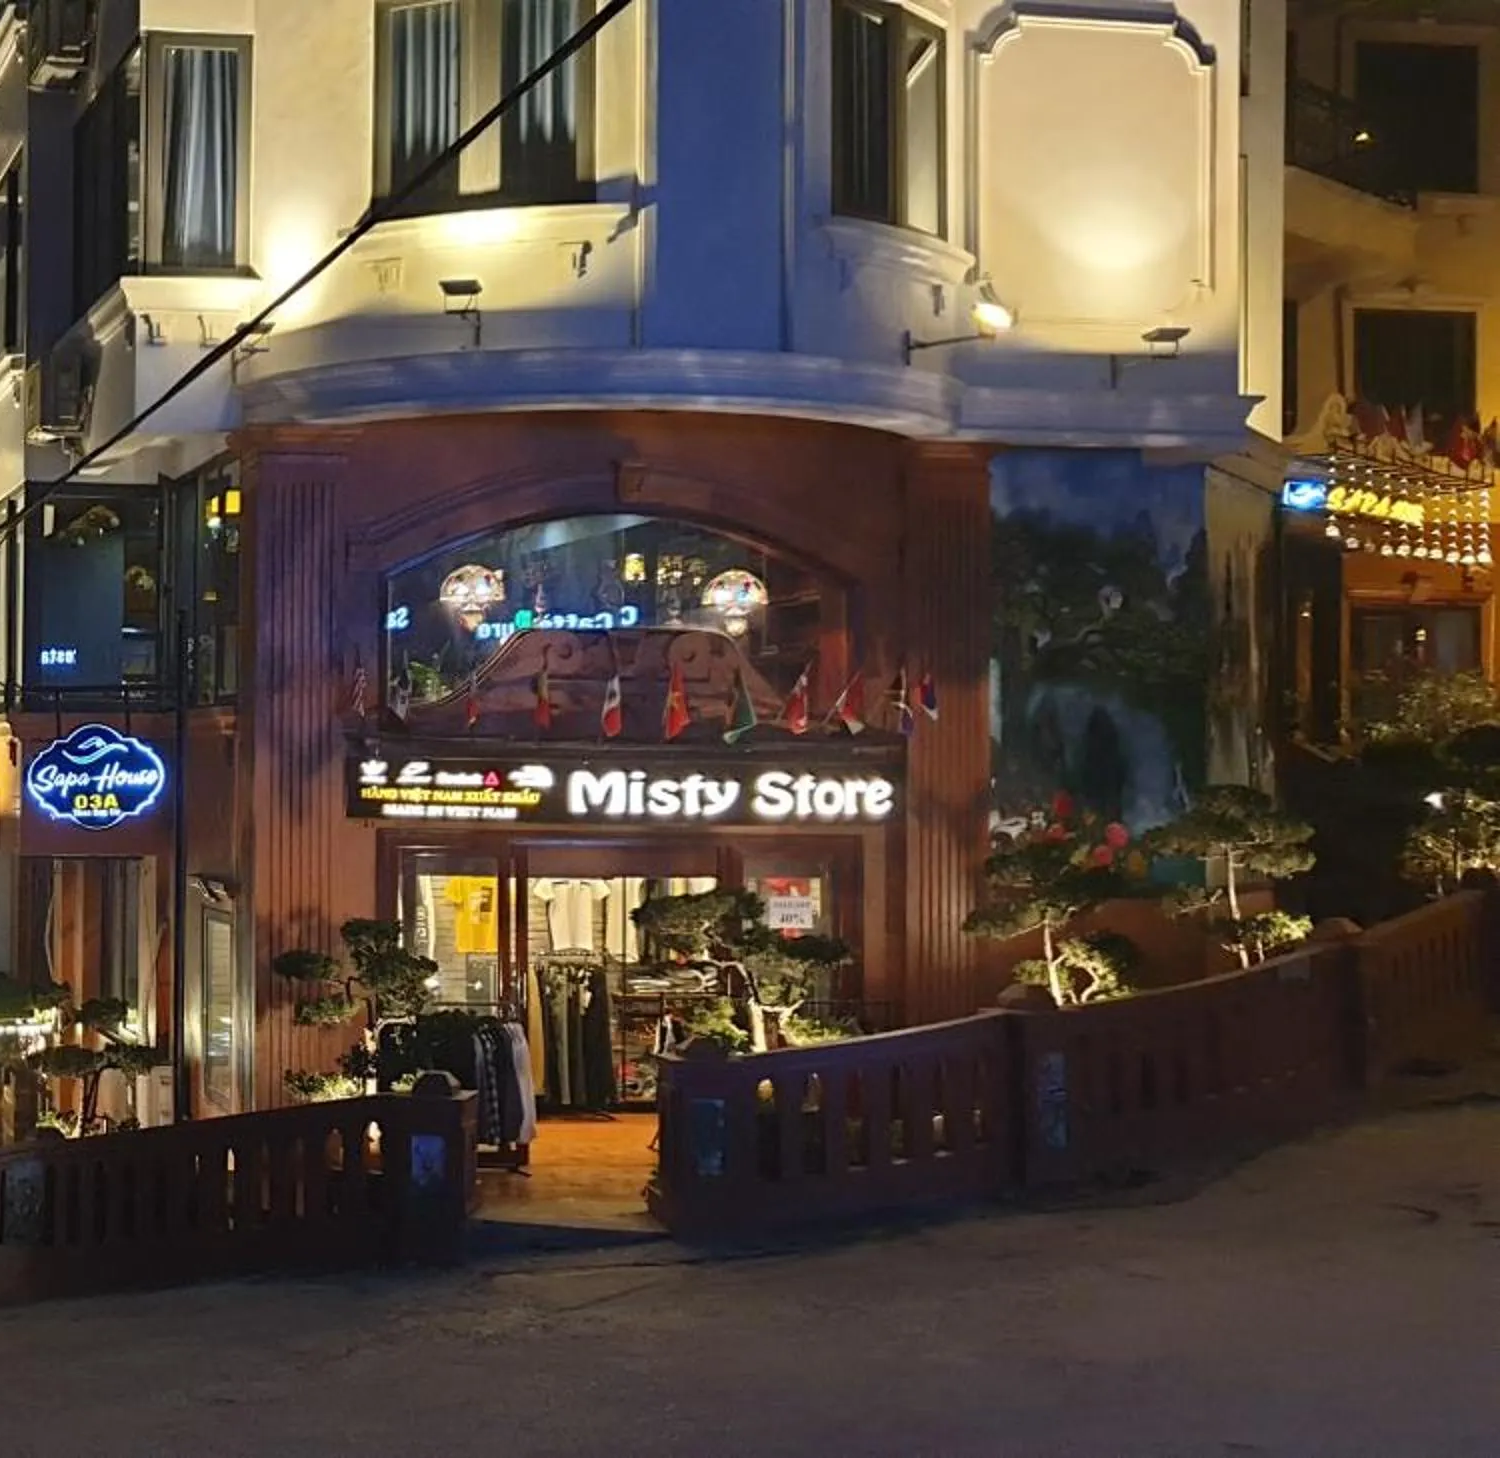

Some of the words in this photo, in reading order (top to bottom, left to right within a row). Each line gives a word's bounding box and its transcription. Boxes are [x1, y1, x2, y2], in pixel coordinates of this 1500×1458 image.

[33, 764, 90, 798] Sapa
[91, 762, 160, 792] House
[567, 770, 741, 818] Misty
[752, 771, 894, 820] Store
[74, 794, 119, 809] 03A
